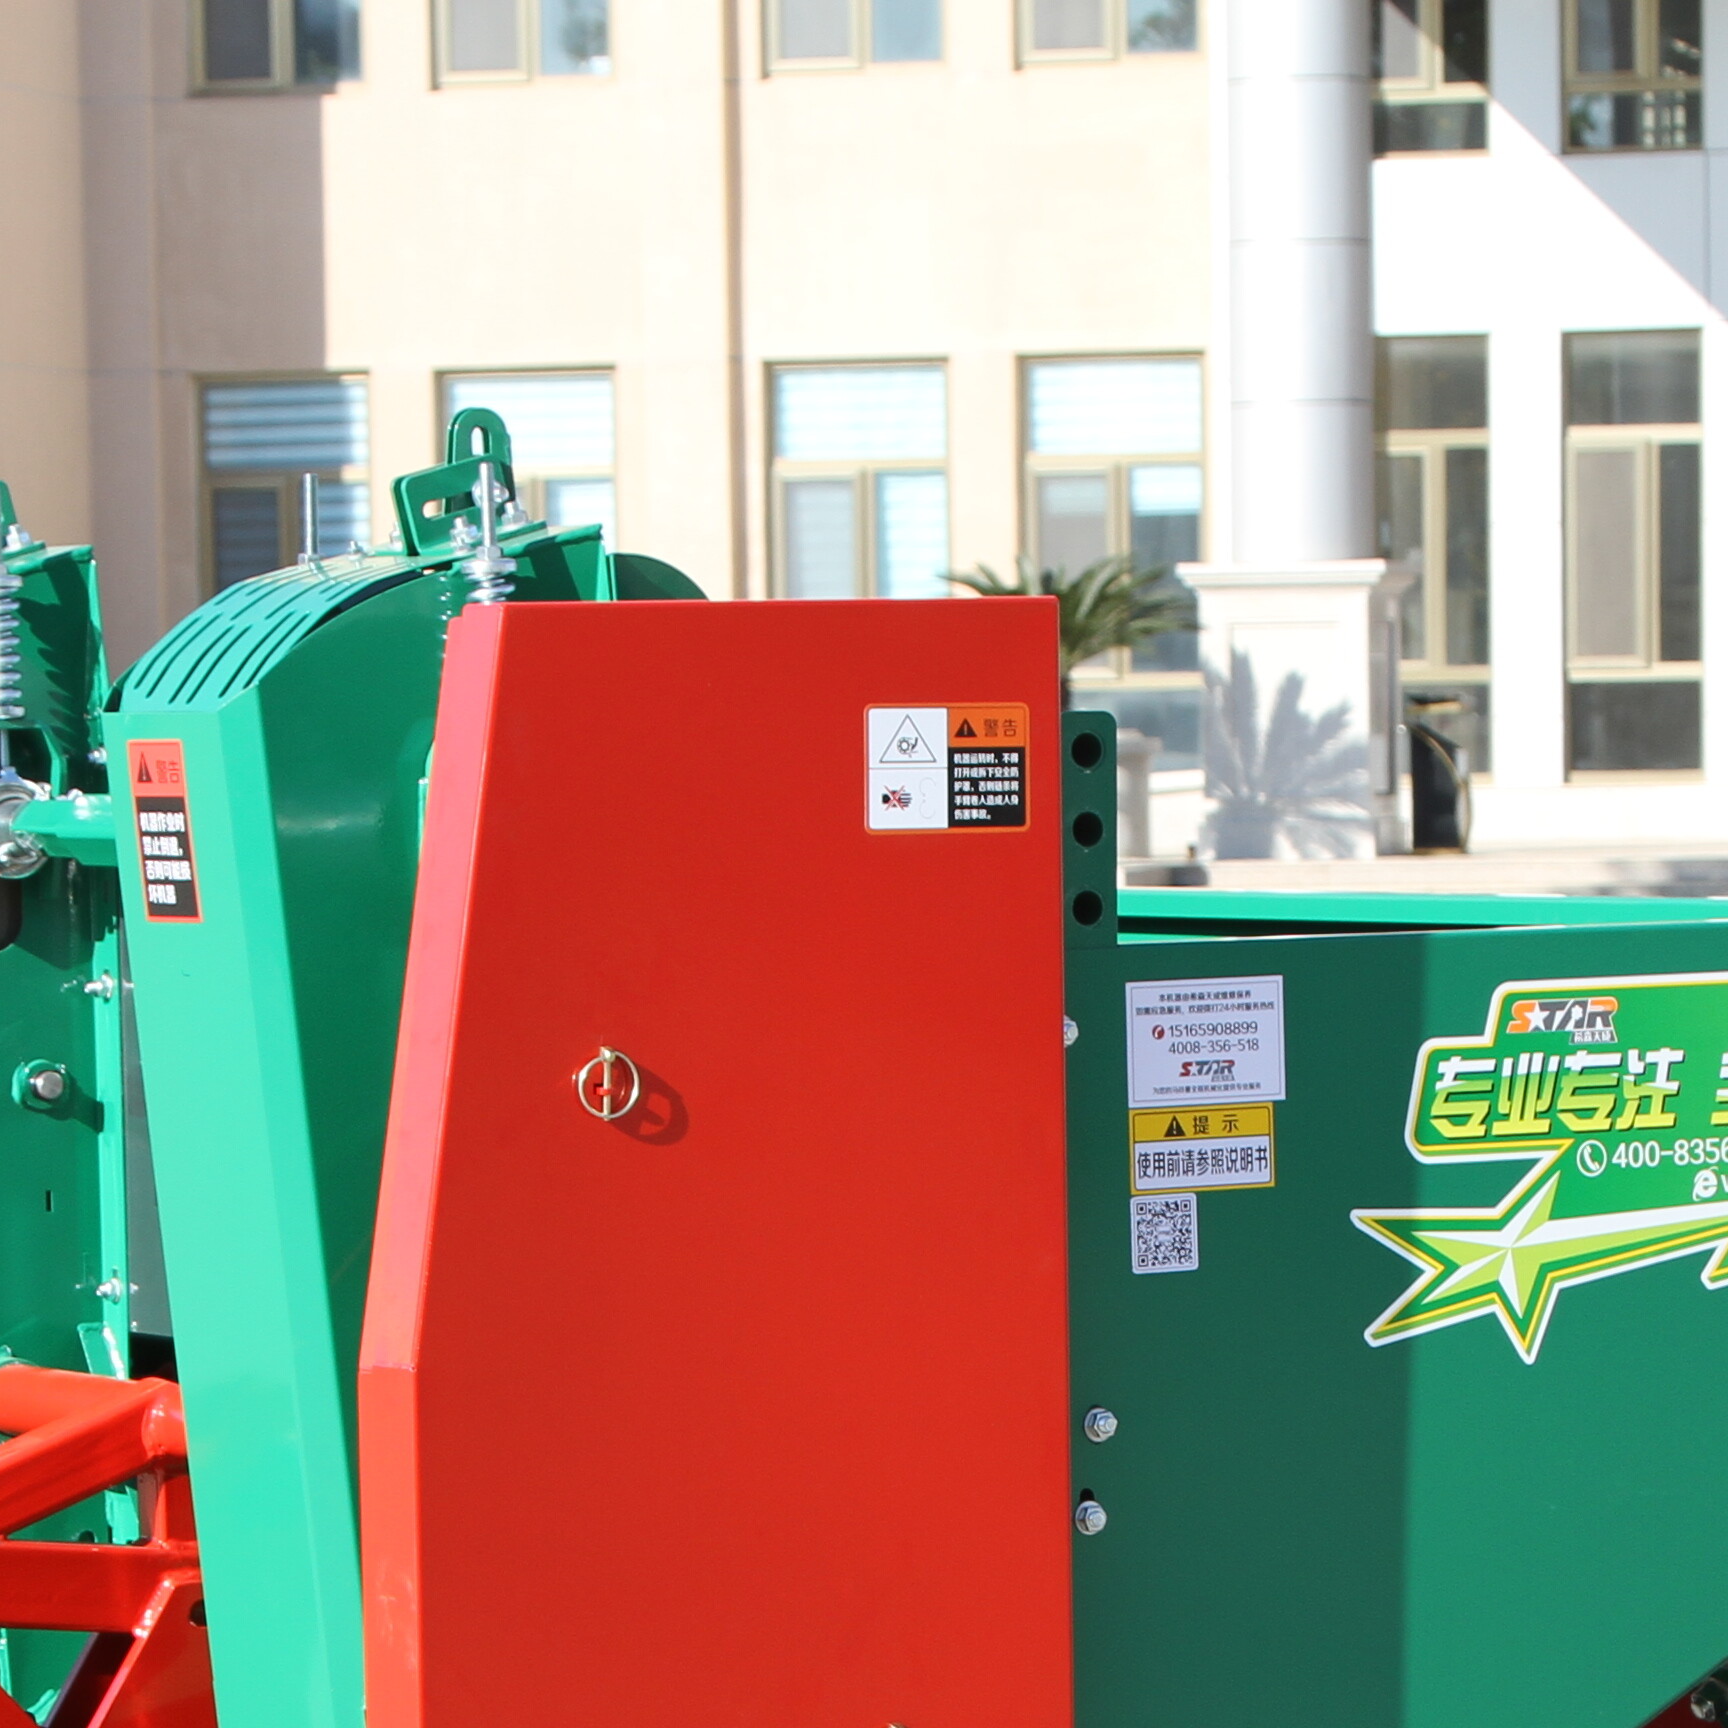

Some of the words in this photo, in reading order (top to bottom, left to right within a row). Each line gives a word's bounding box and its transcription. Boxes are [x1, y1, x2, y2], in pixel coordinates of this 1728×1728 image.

[983, 718, 1017, 737] 警告
[1506, 996, 1618, 1033] STAR
[1168, 1021, 1258, 1037] 15165908899
[1169, 1038, 1259, 1054] 4008-356-518
[1179, 1060, 1235, 1076] STAR
[1430, 1048, 1684, 1138] 专业专注
[1192, 1114, 1239, 1135] 提示
[1137, 1145, 1268, 1179] 使用前请参照说明书
